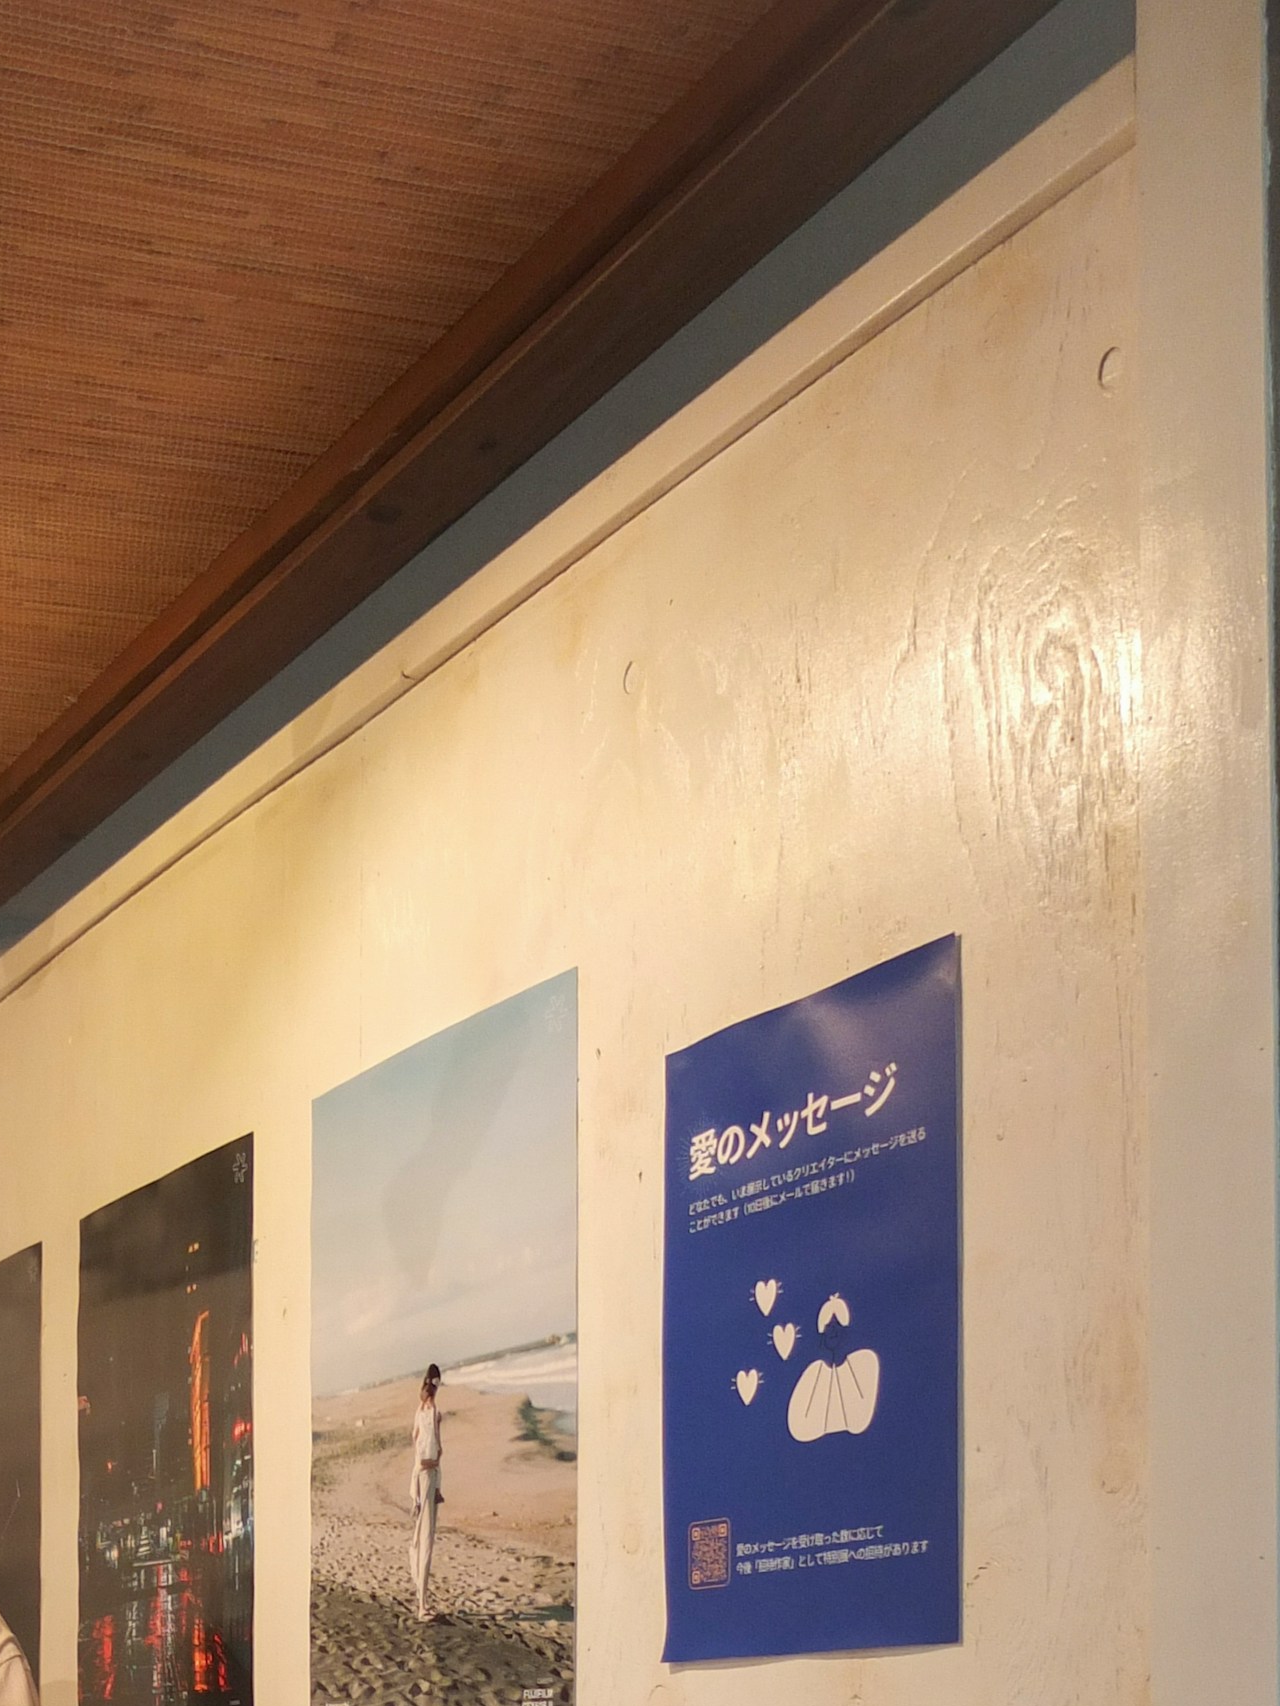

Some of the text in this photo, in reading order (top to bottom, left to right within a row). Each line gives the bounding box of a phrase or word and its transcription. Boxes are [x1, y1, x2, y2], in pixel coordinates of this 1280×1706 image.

[688, 1062, 897, 1181] 愛のメッセージ
